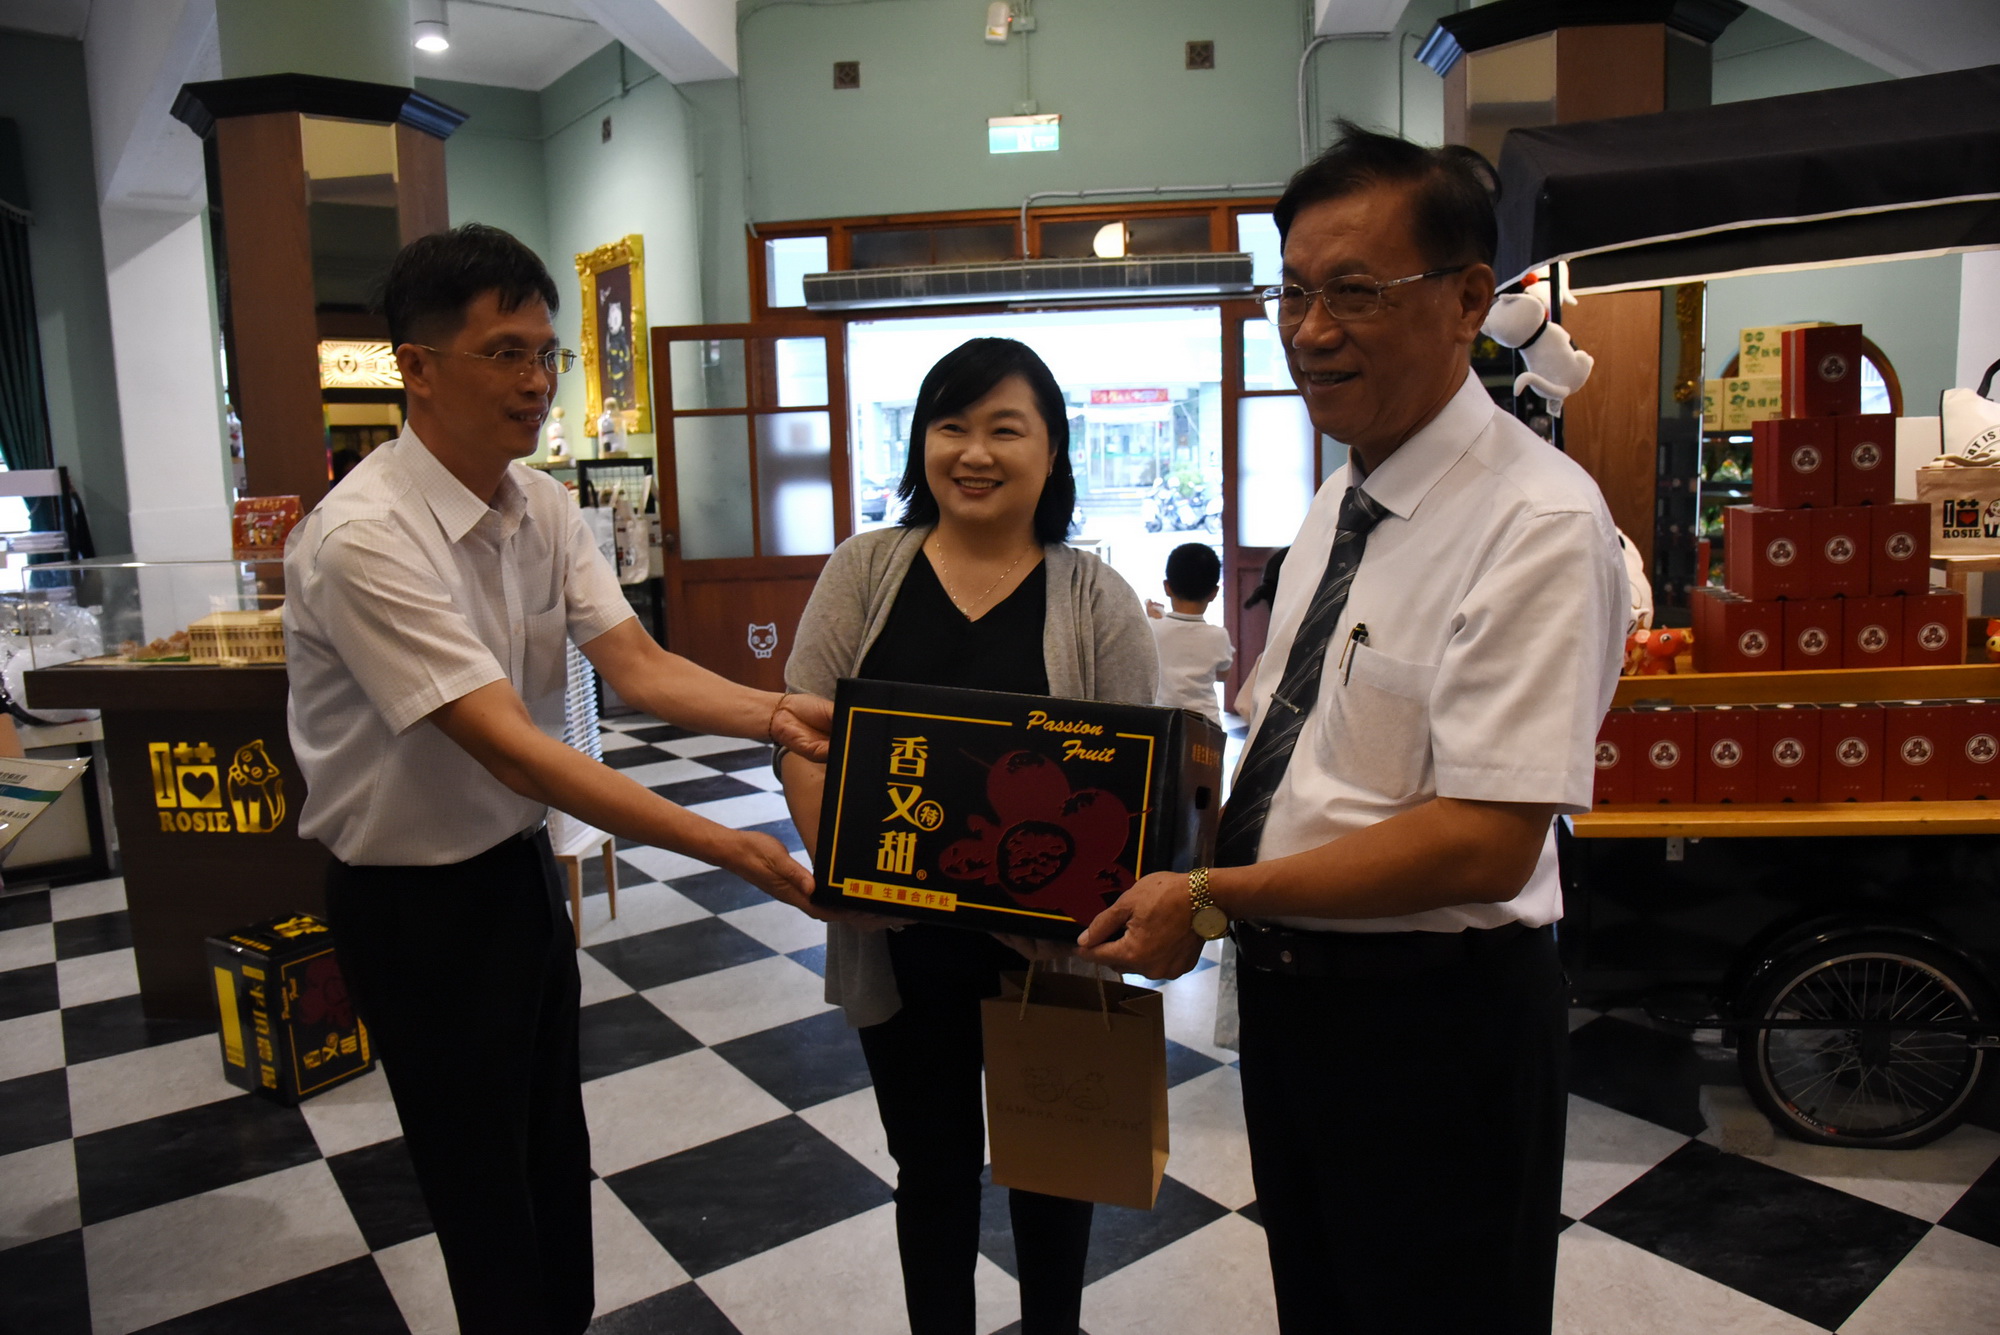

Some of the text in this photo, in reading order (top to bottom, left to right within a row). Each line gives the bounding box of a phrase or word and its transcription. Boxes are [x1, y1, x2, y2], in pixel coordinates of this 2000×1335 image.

[1982, 430, 1996, 443] IS
[1943, 529, 1981, 538] ROSIE
[1026, 709, 1105, 737] Passion
[1060, 740, 1115, 764] Fruit
[876, 735, 929, 876] 香又甜
[917, 803, 942, 828] 特
[158, 811, 231, 833] ROSIE
